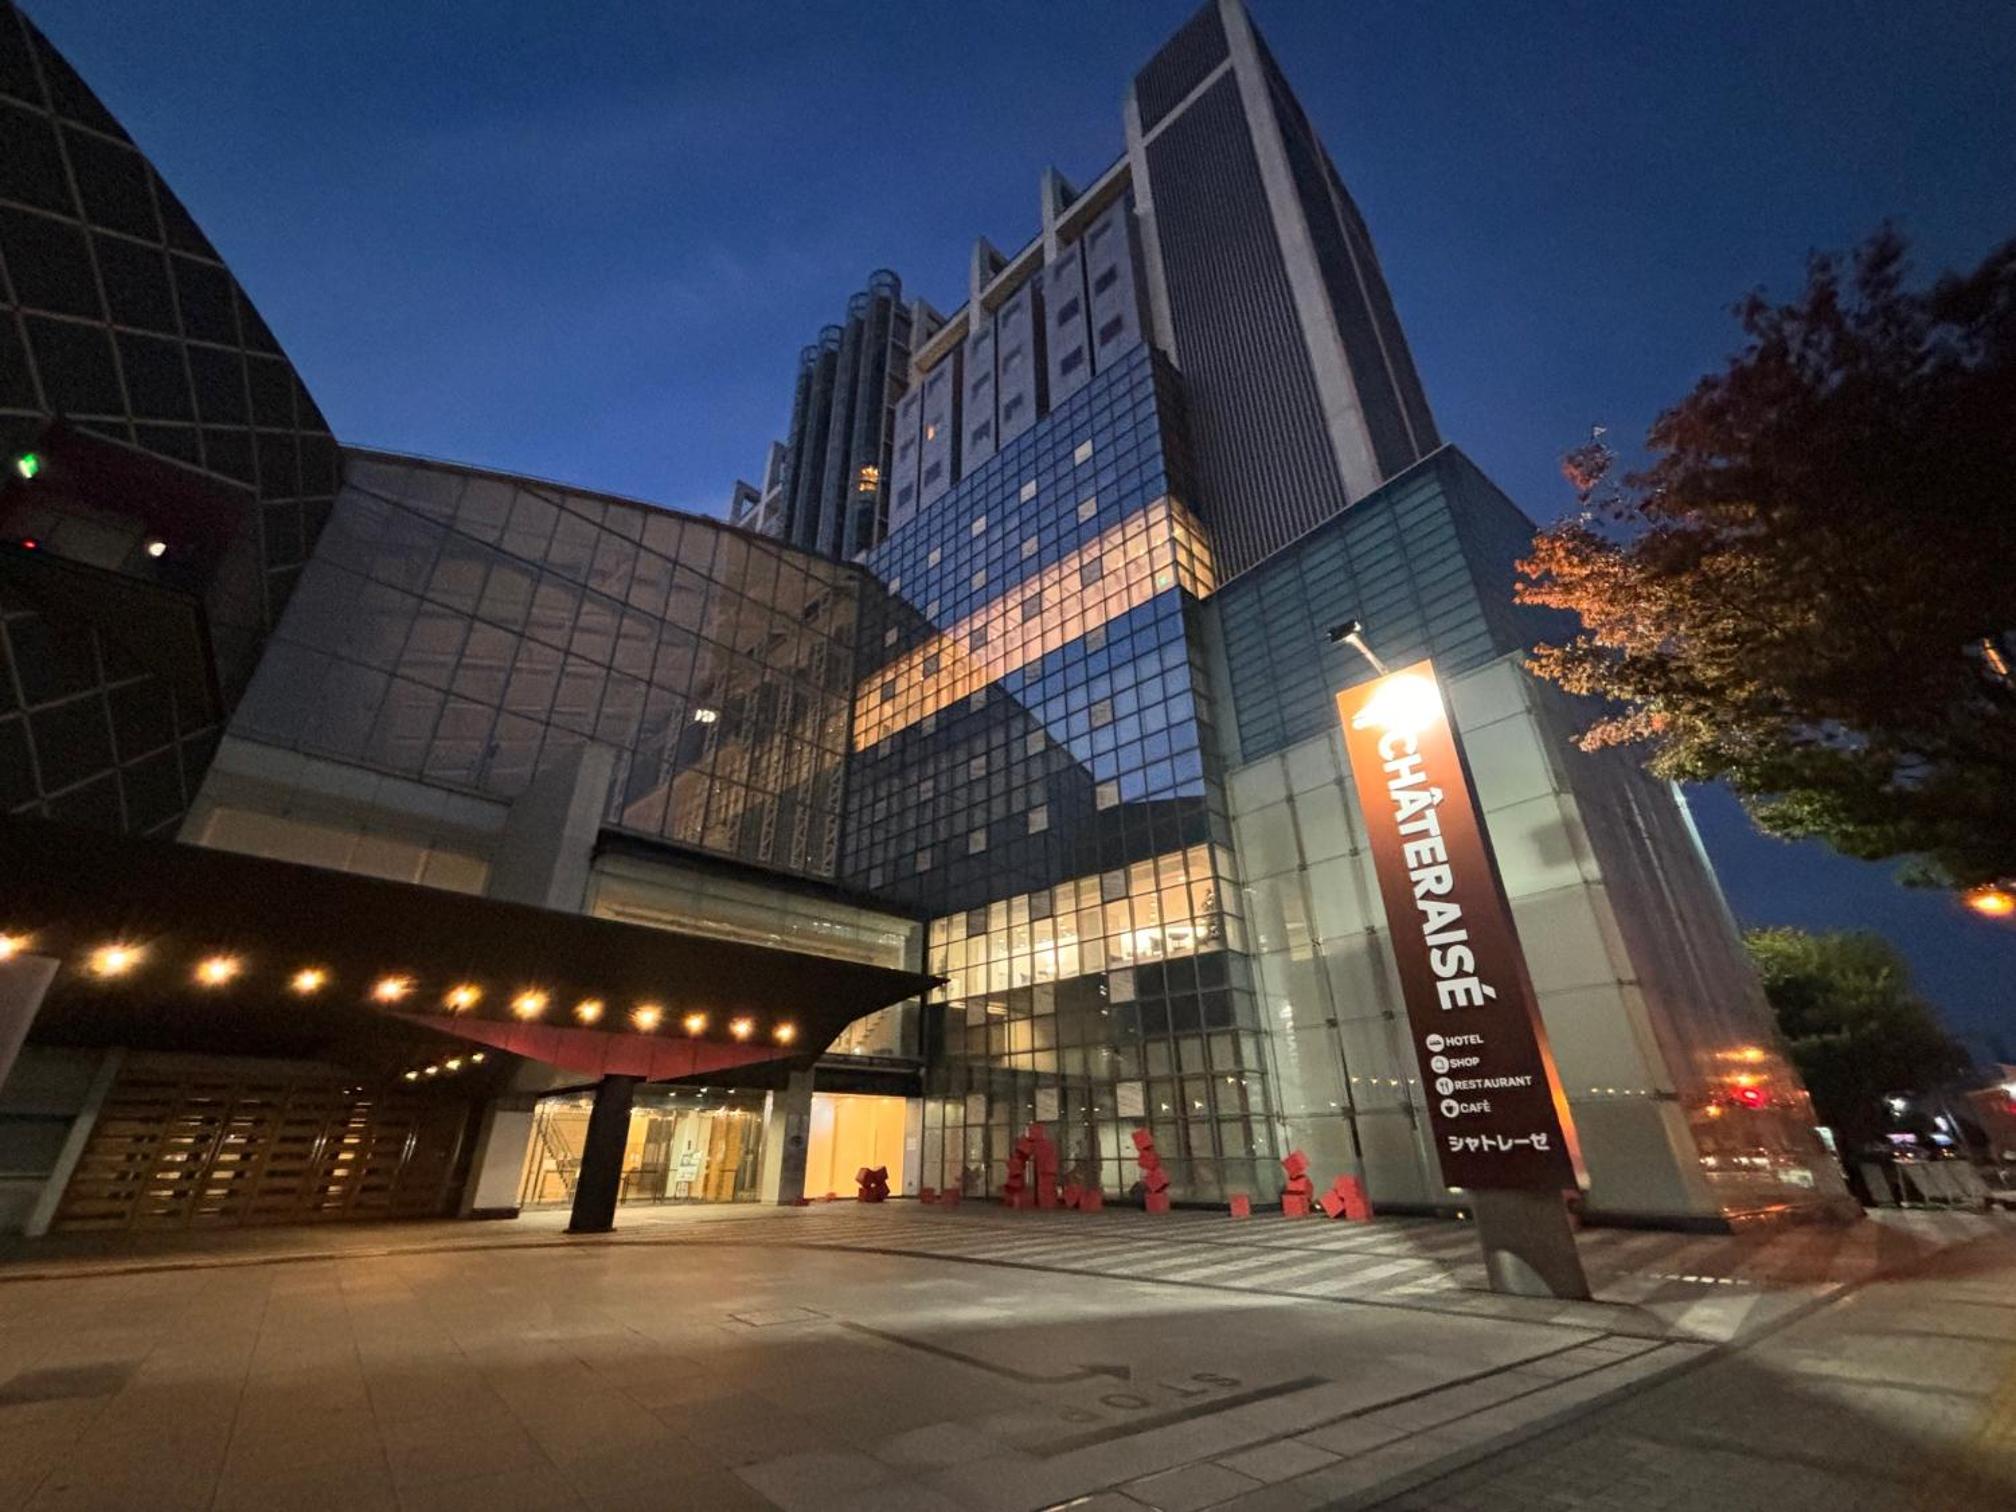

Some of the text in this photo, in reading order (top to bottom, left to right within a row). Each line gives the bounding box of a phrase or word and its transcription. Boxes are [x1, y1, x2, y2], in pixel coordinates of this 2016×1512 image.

[1378, 730, 1497, 1011] CHÂTERAISÉ
[1445, 1034, 1484, 1047] HOTEL
[1449, 1057, 1480, 1069] SHOP
[1454, 1076, 1532, 1091] RESTAURANT
[1448, 1133, 1550, 1152] シャトレーゼ
